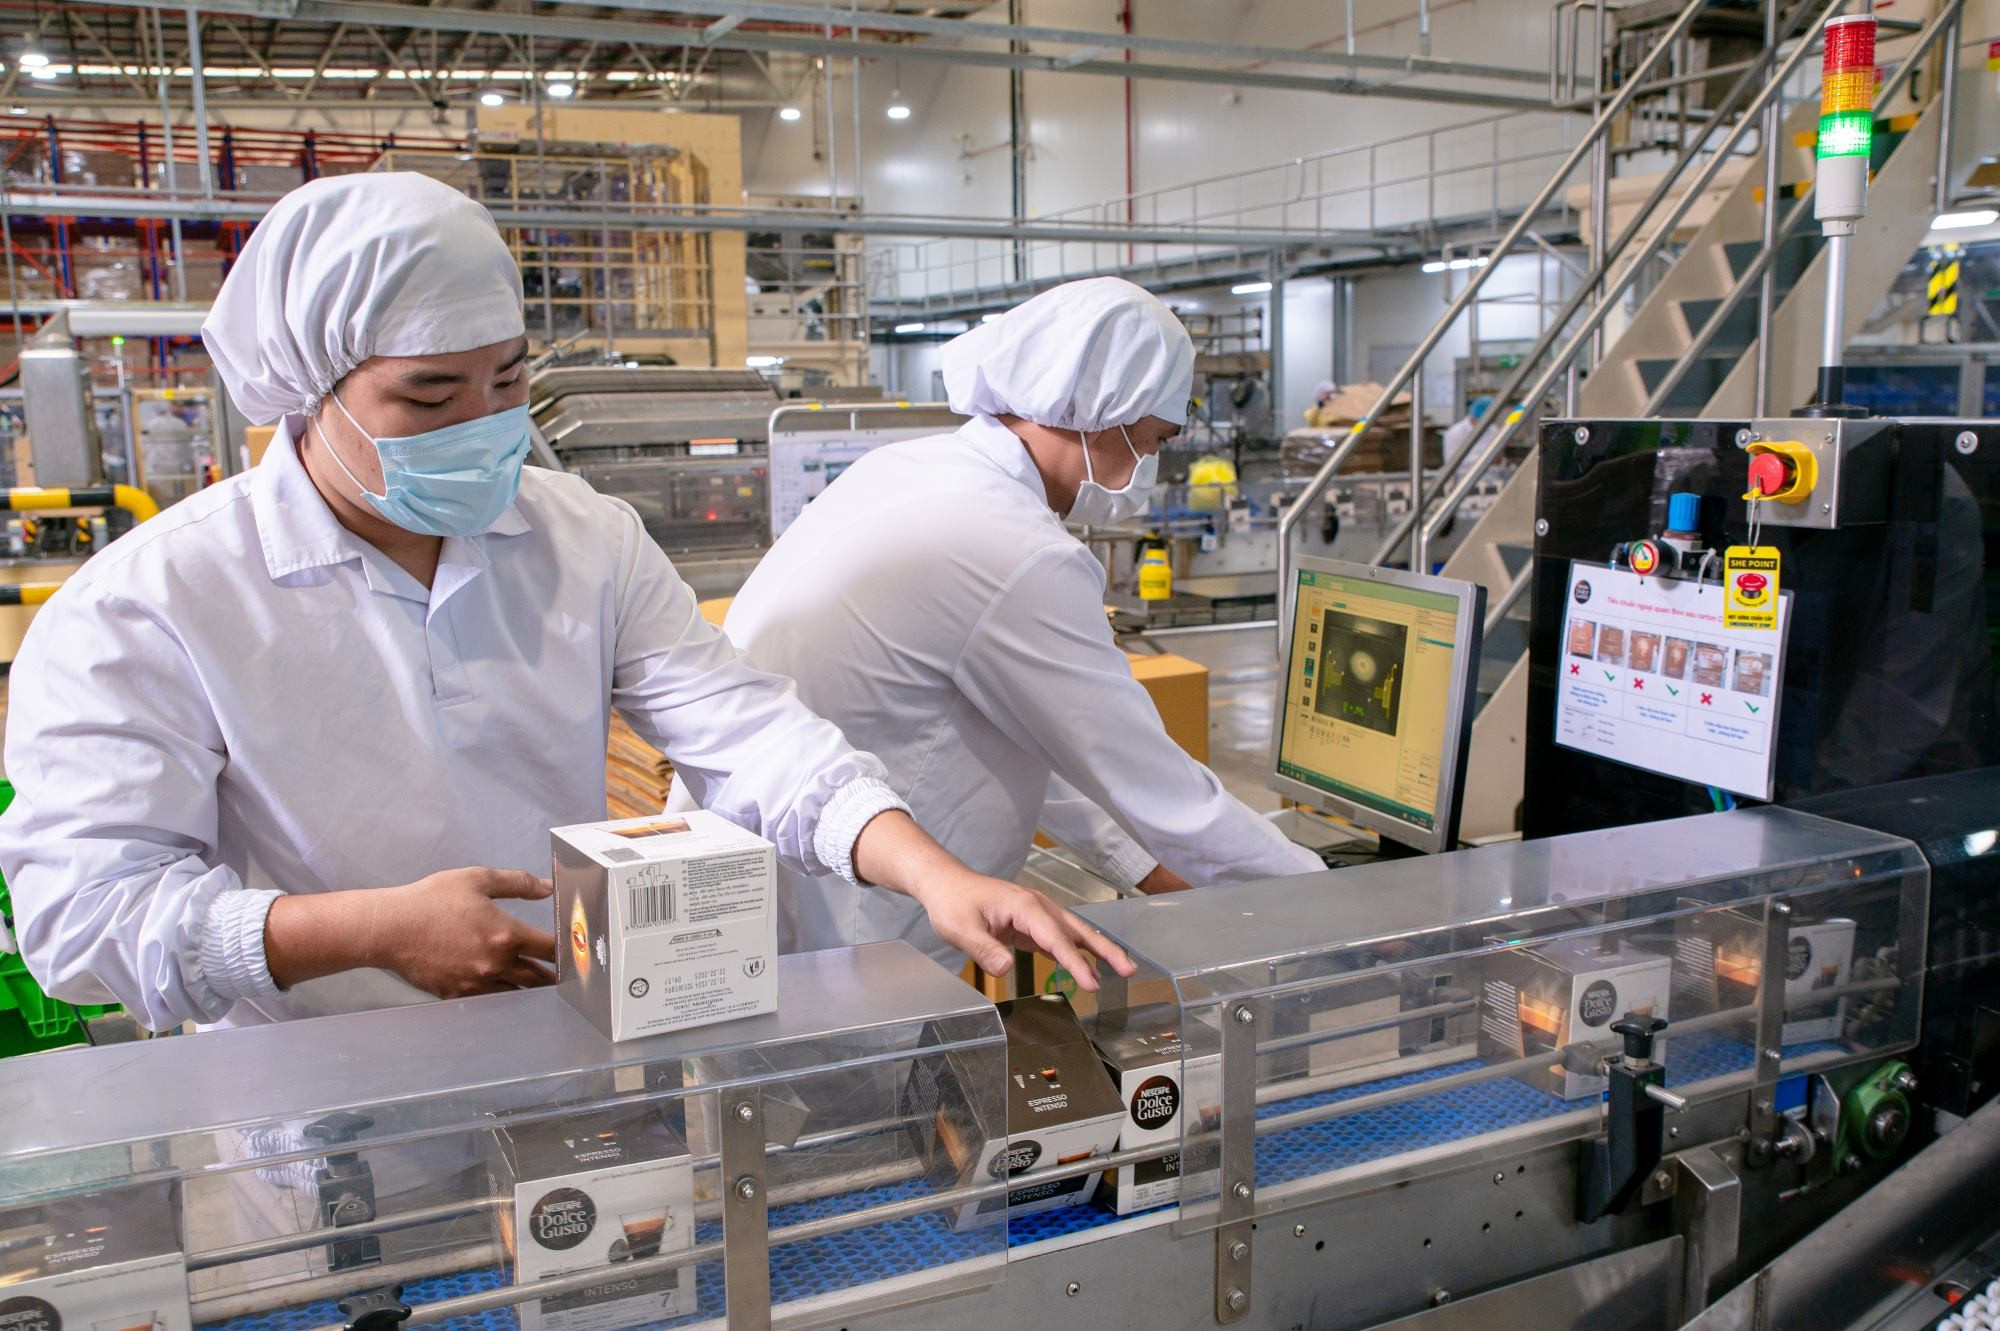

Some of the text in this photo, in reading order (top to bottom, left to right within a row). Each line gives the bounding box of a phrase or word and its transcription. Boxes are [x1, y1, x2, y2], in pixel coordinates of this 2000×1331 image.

[1731, 559, 1775, 568] SHE POINT
[1027, 1093, 1068, 1107] ESPRESSO
[1033, 1101, 1068, 1113] INTENSO
[1137, 1095, 1173, 1110] Dolce
[1137, 1105, 1173, 1120] Gusto
[574, 1147, 621, 1159] ESPRESSO
[580, 1152, 620, 1163] INTENSO
[1010, 1182, 1060, 1198] ESPRESSO
[1011, 1189, 1054, 1203] INTENSO
[538, 1210, 587, 1229] Dolce
[540, 1222, 588, 1239] Gusto
[44, 1245, 105, 1261] ESPRESSO
[48, 1251, 100, 1264] INTENSO
[583, 1280, 638, 1298] INTENSO
[659, 1292, 671, 1308] 7
